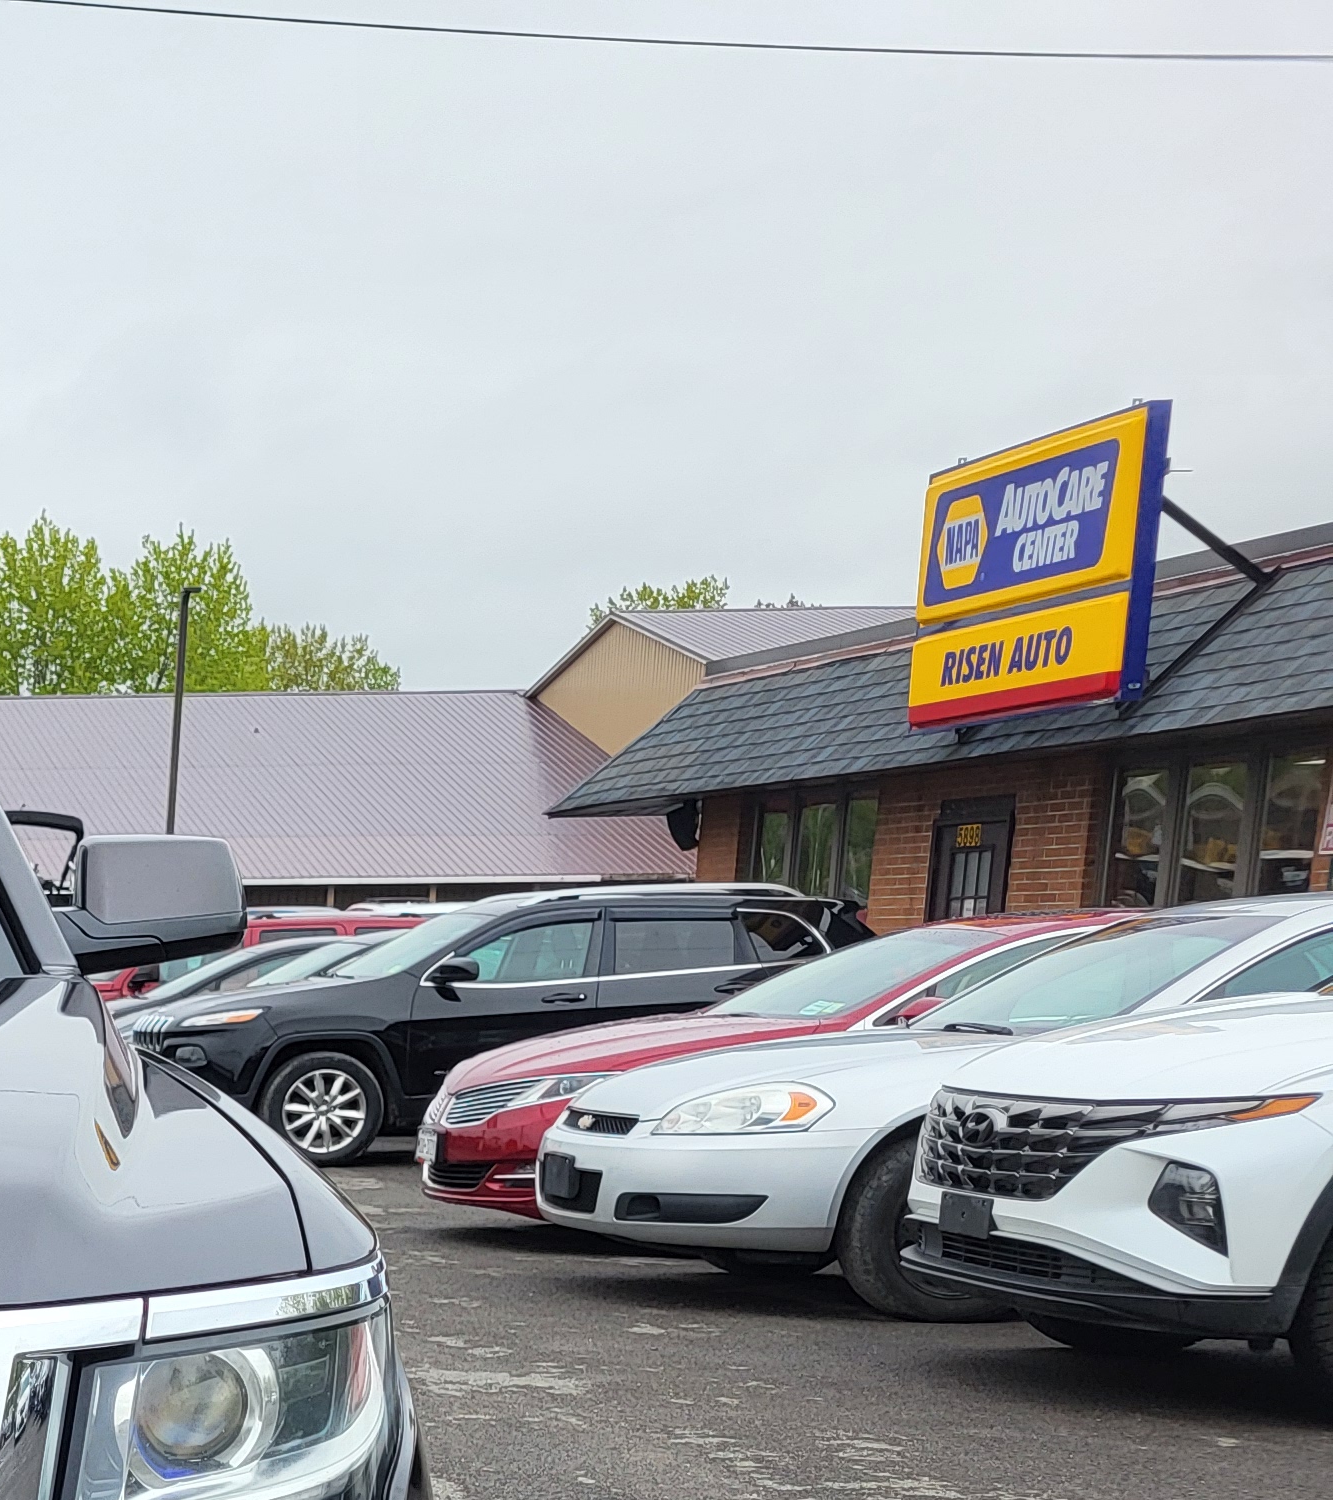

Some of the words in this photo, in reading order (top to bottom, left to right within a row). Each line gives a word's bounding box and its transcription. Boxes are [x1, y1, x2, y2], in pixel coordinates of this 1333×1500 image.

[943, 517, 981, 568] NAPA
[1012, 520, 1080, 573] CENTER
[939, 639, 1005, 688] RISEN
[1006, 625, 1074, 676] AUTO
[956, 824, 981, 848] 5898
